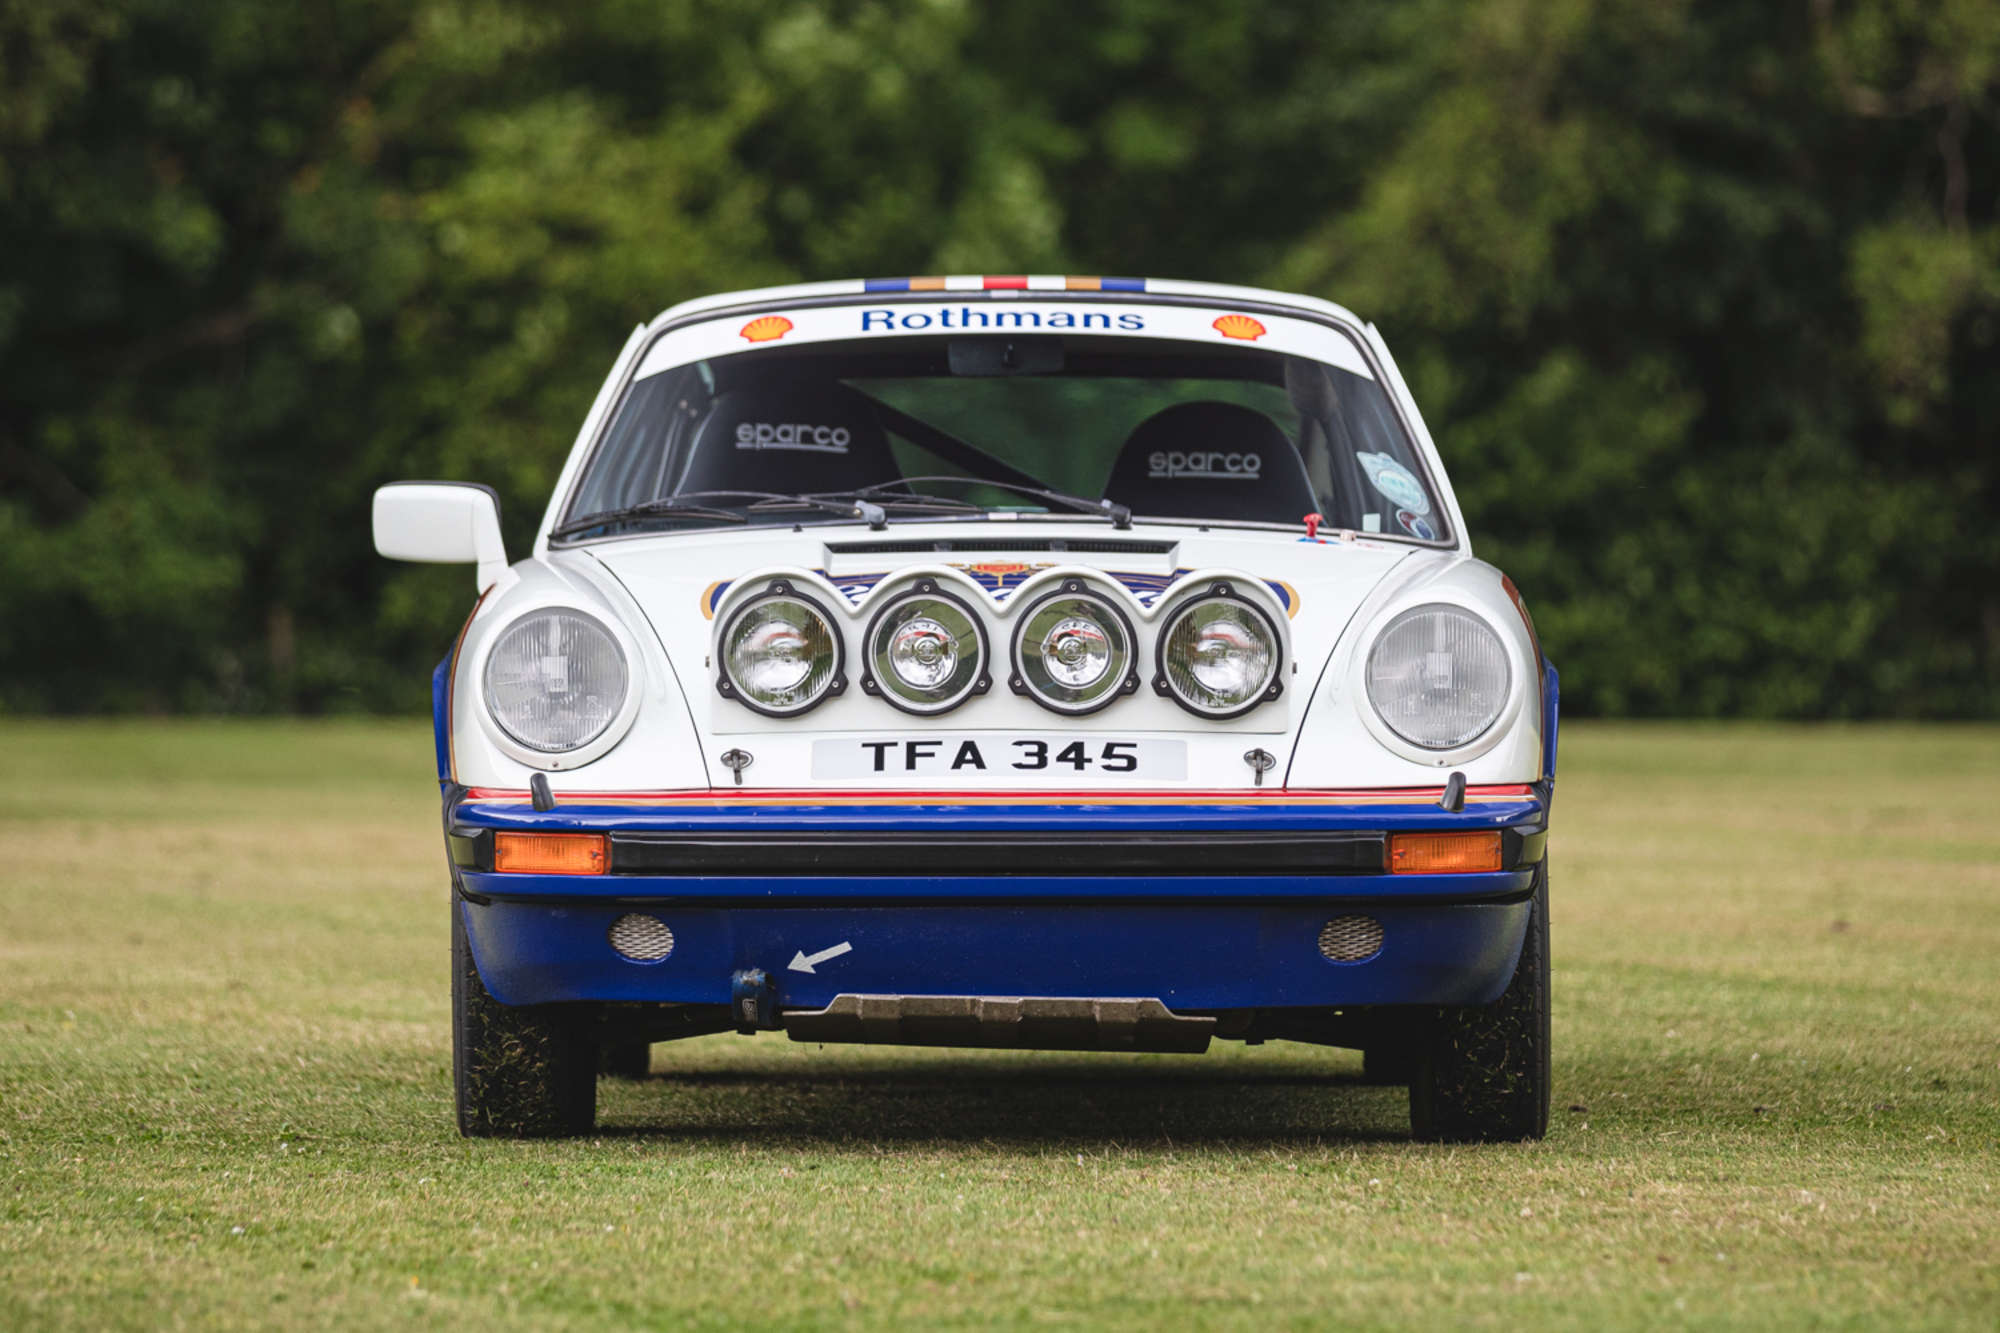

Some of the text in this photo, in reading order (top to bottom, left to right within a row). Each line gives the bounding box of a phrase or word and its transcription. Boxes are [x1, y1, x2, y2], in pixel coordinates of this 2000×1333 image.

[861, 307, 1145, 332] Rothmans
[736, 422, 850, 452] sparco
[1149, 450, 1261, 479] sparco
[861, 740, 1138, 772] TFA 345
